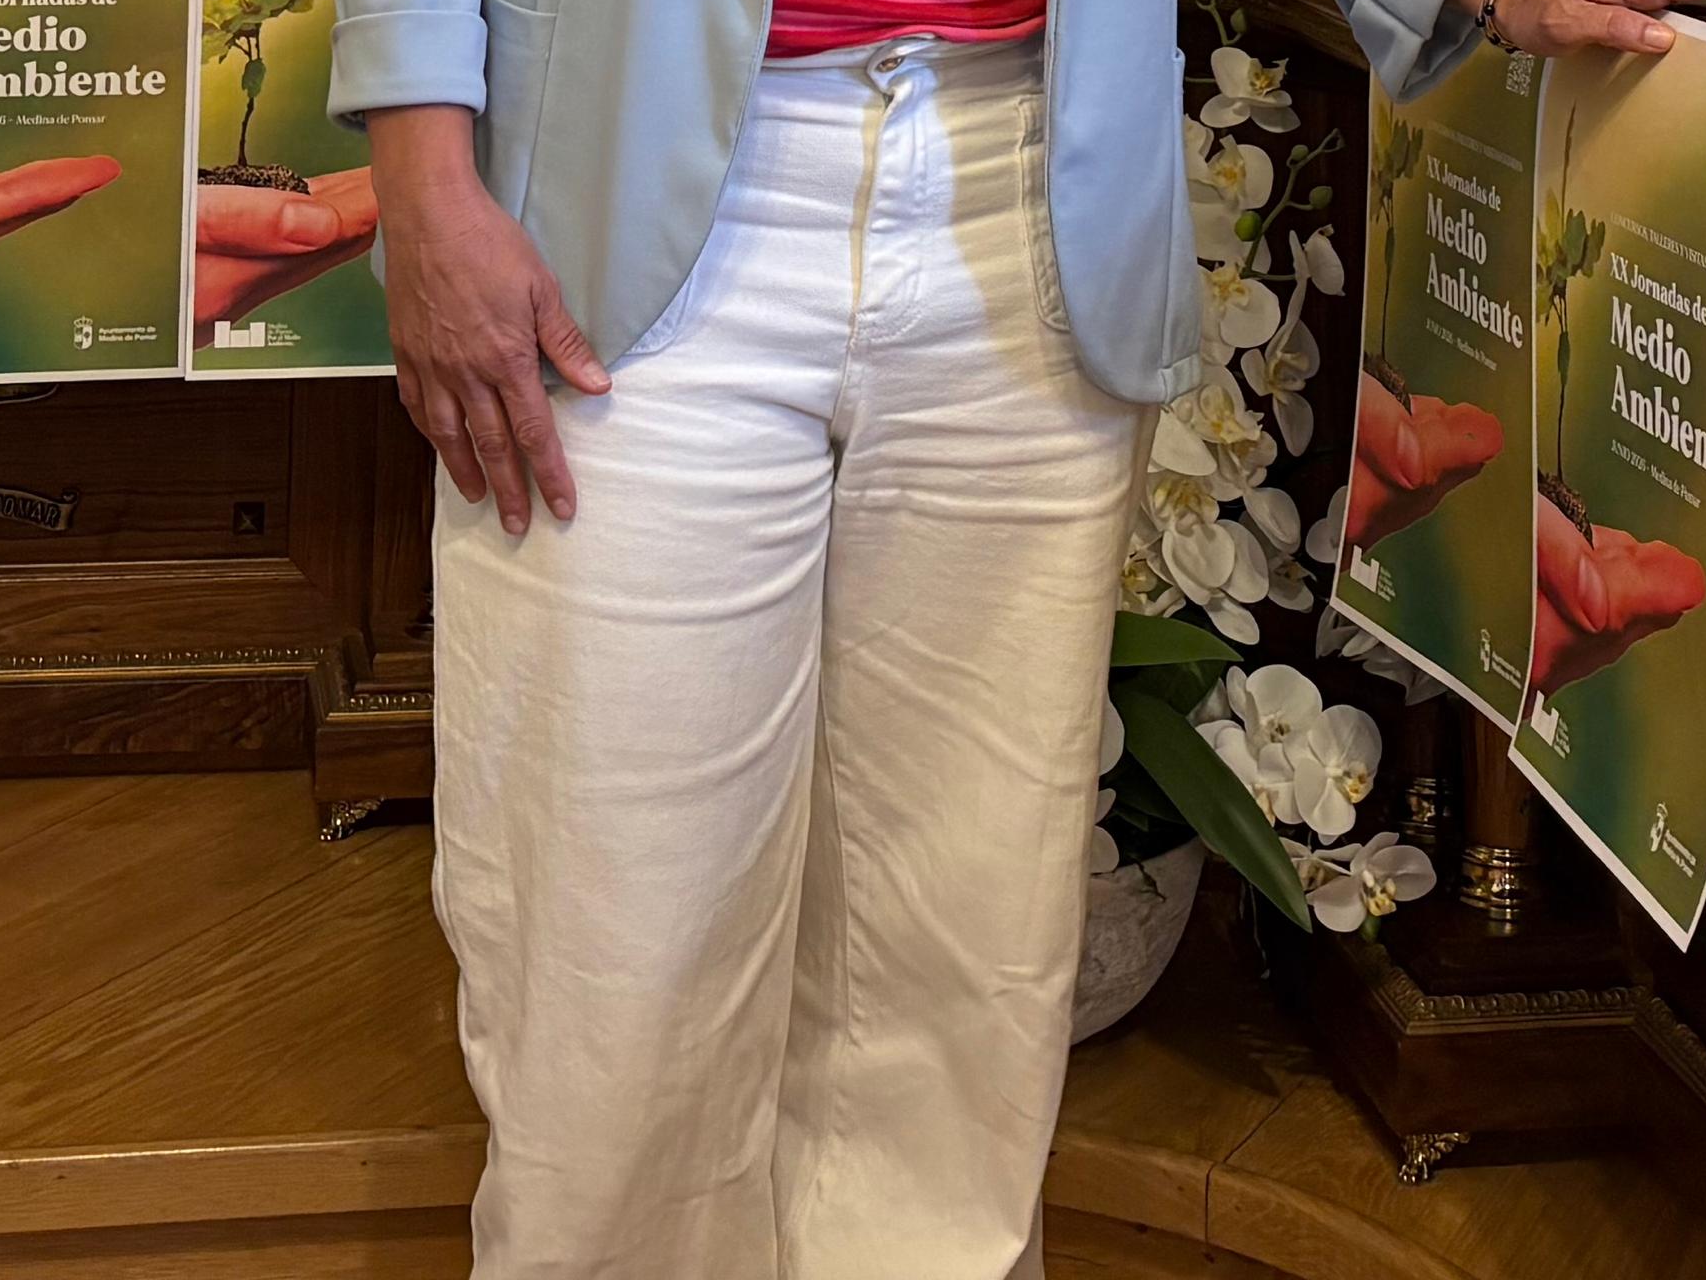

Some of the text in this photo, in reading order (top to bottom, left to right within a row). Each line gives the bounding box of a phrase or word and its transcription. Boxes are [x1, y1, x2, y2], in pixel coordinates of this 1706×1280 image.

[15, 114, 55, 126] Medina
[56, 114, 70, 125] de
[71, 114, 107, 125] Pomar
[1426, 153, 1502, 213] XX Jornadas de
[1426, 192, 1487, 265] Medio
[1426, 251, 1524, 350] Ambiente
[1610, 251, 1629, 285] XX
[1630, 263, 1691, 317] Jornadas
[1610, 295, 1692, 386] Medio
